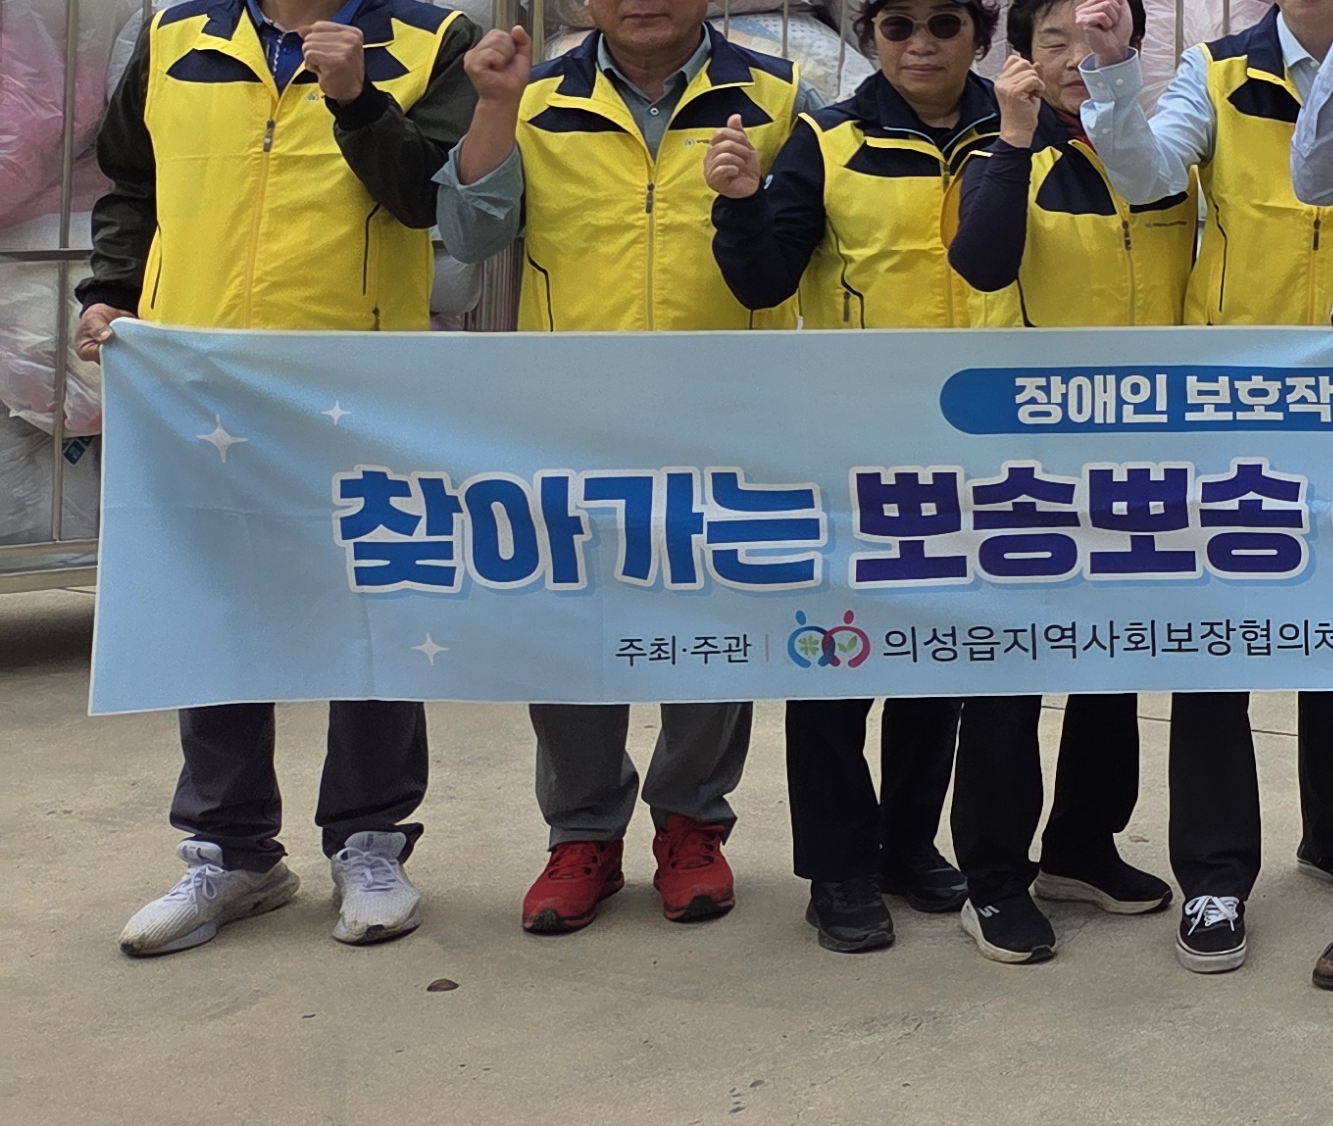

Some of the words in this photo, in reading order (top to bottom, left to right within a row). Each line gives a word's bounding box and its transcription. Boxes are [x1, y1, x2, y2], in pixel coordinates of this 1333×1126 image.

[1014, 375, 1169, 425] 장애인
[335, 466, 826, 593] 찾아가는
[851, 458, 1306, 588] 뽀송뽀송
[616, 635, 752, 667] 주최·주관
